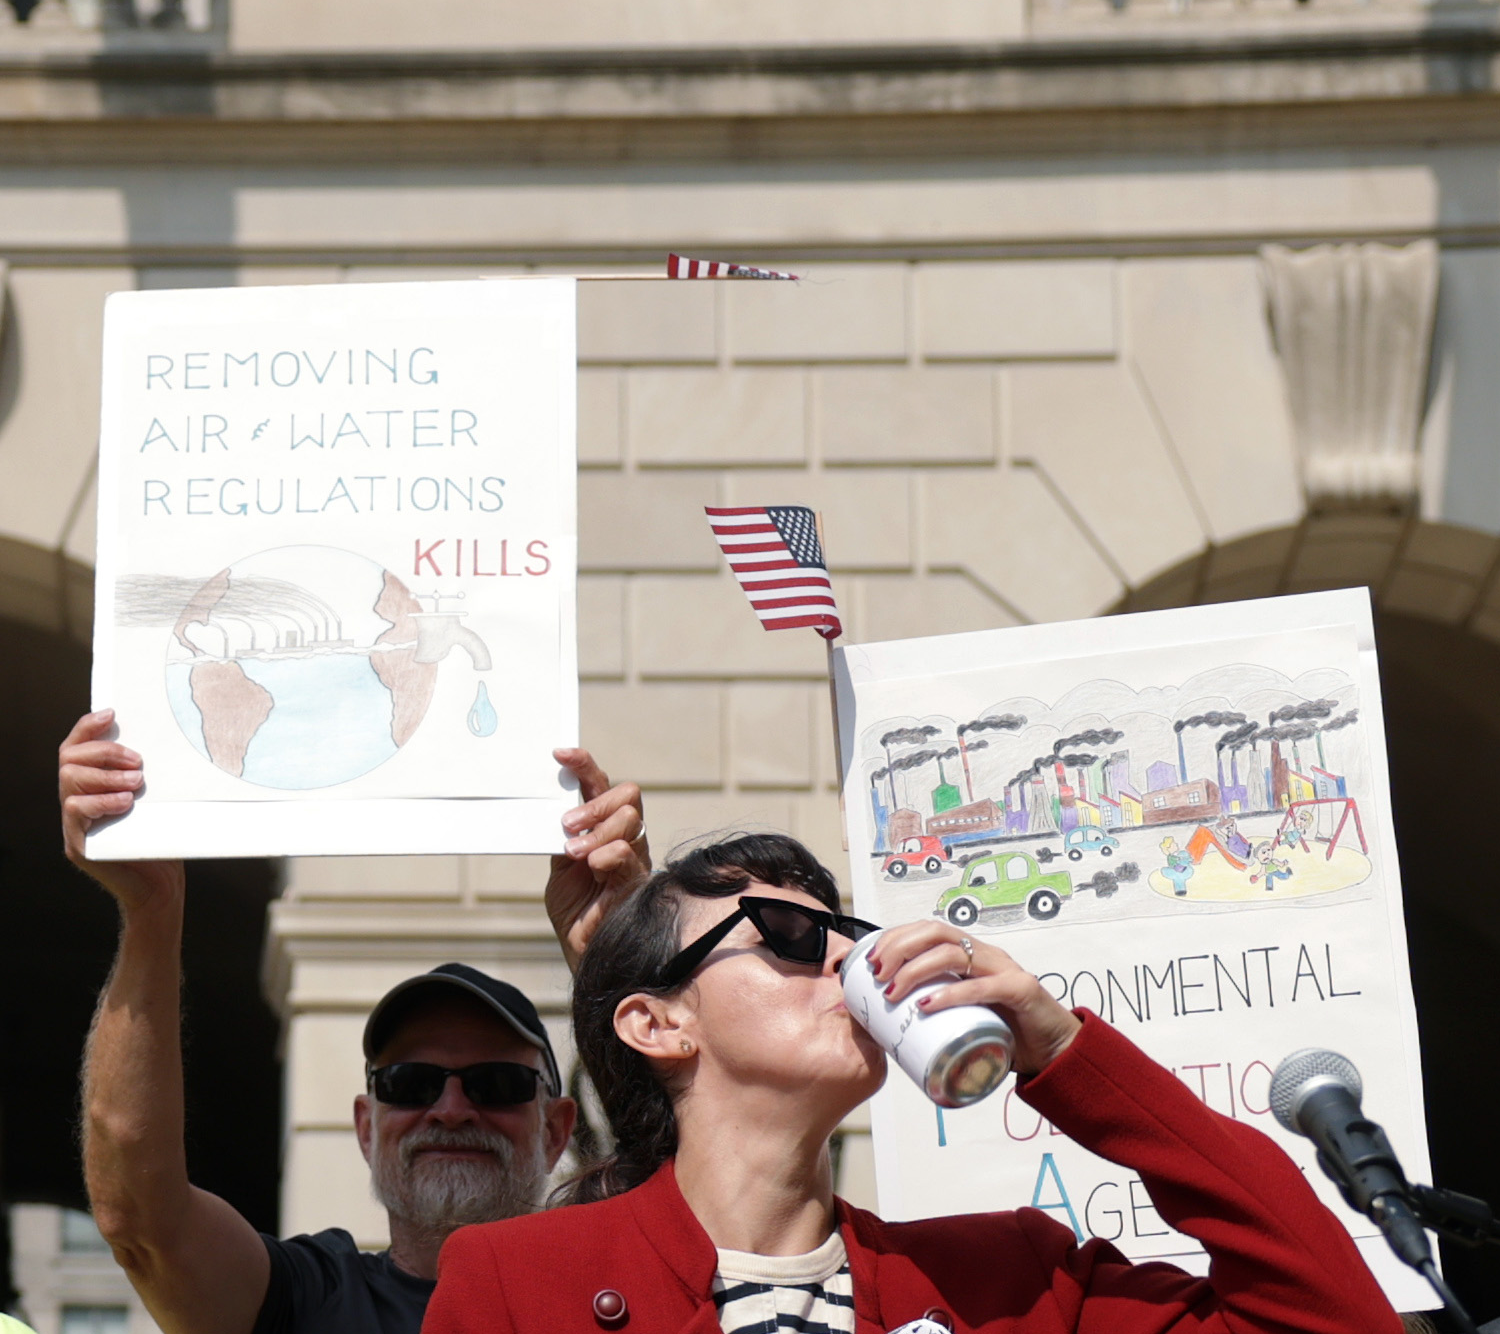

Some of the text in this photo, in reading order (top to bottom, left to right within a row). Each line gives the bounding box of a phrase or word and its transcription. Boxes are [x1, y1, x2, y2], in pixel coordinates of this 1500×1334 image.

[146, 347, 439, 390] REMOVING
[139, 414, 229, 454] AIR
[290, 409, 478, 451] WATER
[143, 476, 506, 516] REGULATIONS
[413, 538, 552, 577] KILLS
[1031, 1152, 1170, 1243] AGE
